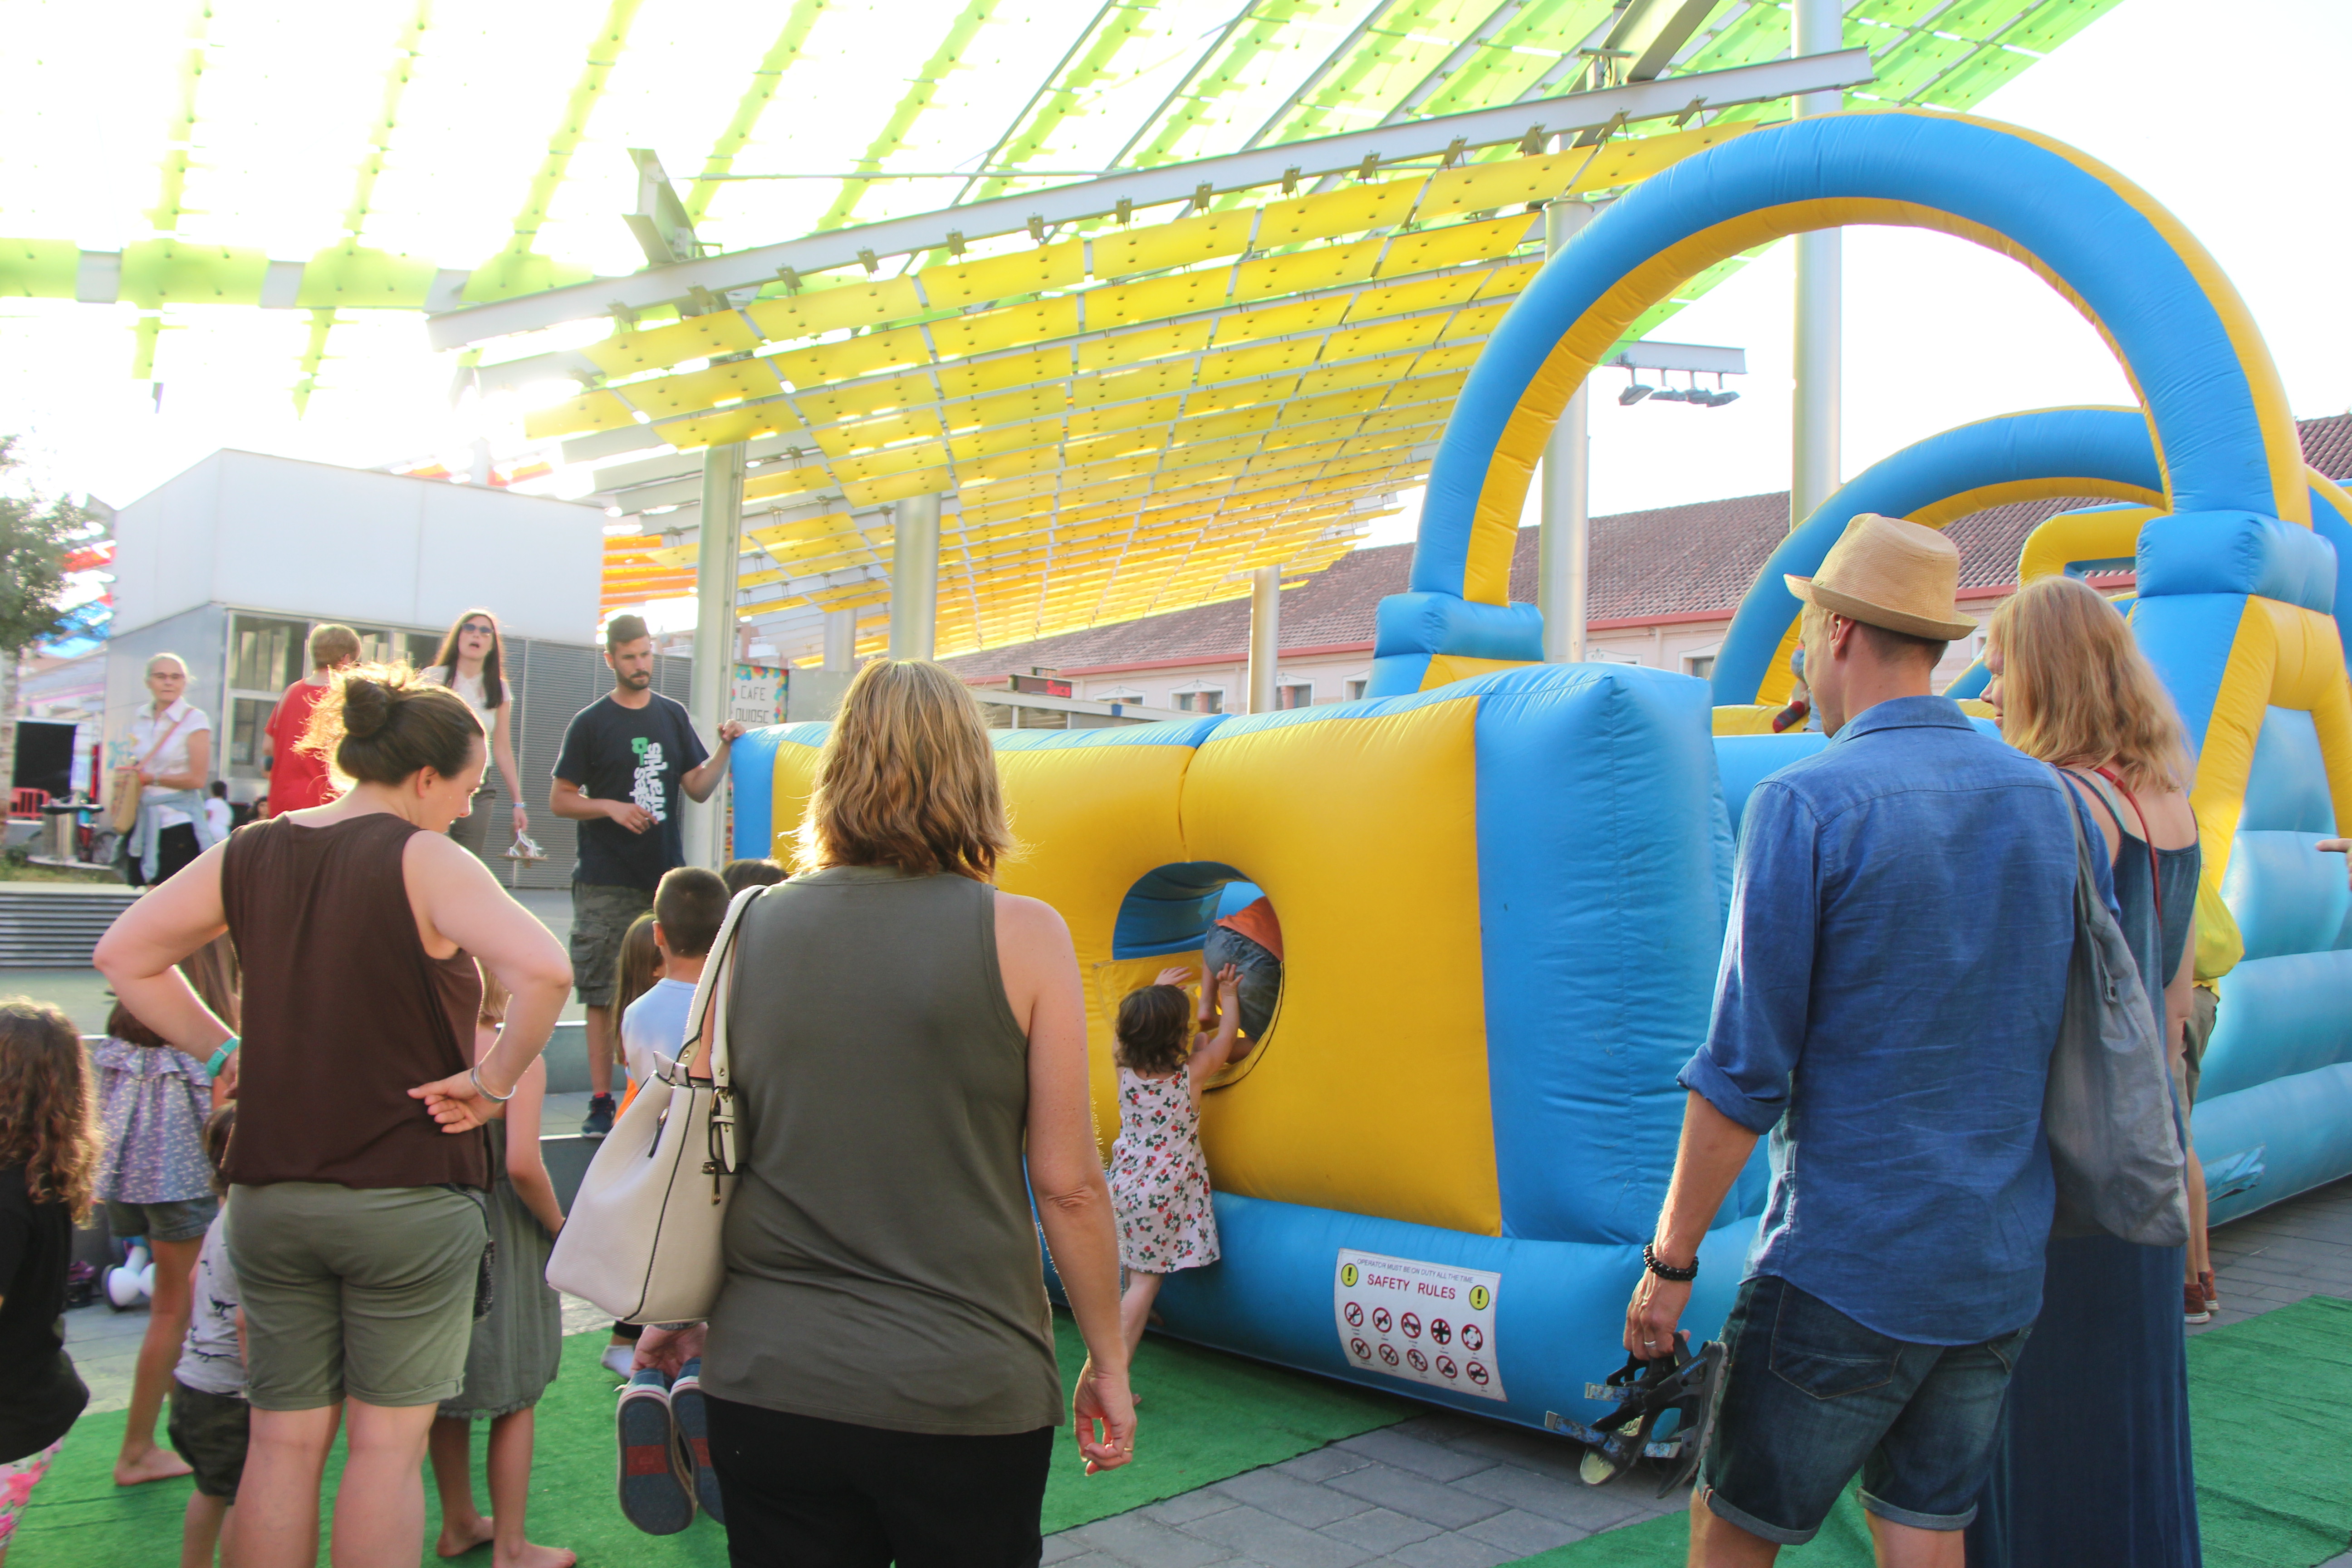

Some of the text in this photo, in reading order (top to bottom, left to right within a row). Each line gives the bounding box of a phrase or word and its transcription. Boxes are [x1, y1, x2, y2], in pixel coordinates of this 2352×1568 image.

[741, 685, 766, 701] CAFE
[1357, 1258, 1387, 1268] OPERATOR
[1367, 1274, 1456, 1299] SAFETY RULES
